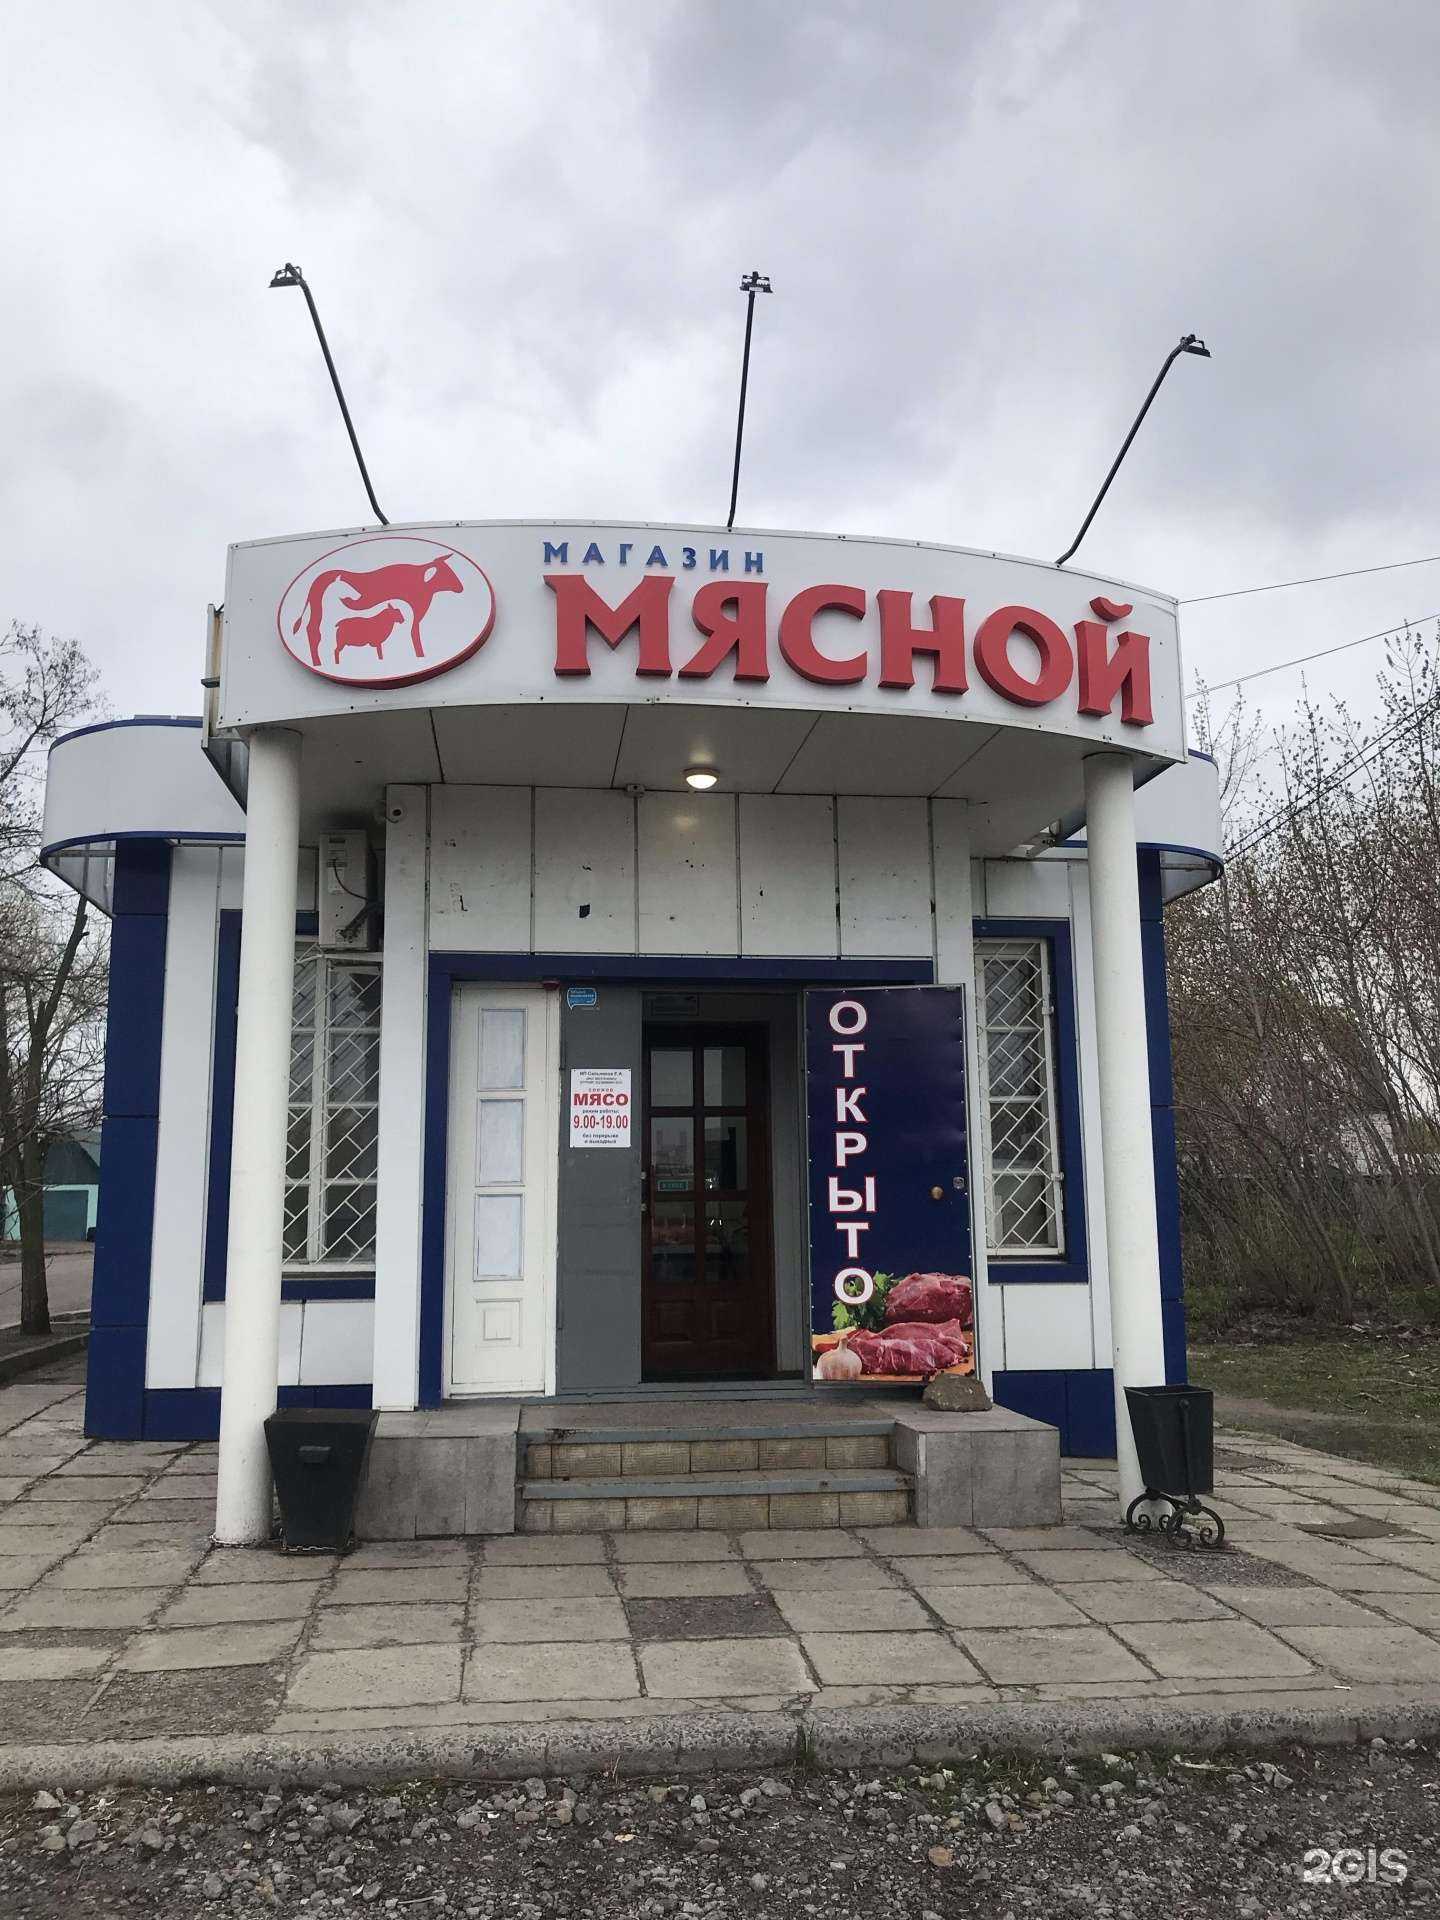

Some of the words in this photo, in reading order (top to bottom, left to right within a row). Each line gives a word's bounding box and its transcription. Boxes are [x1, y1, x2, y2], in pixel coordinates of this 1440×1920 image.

[543, 541, 764, 573] МАГАЗИН
[543, 574, 1154, 727] МЯСНОЙ
[573, 1093, 629, 1106] МЯСО
[573, 1114, 628, 1129] 9.00-19.00
[828, 1000, 877, 1305] ОТКРЫТО
